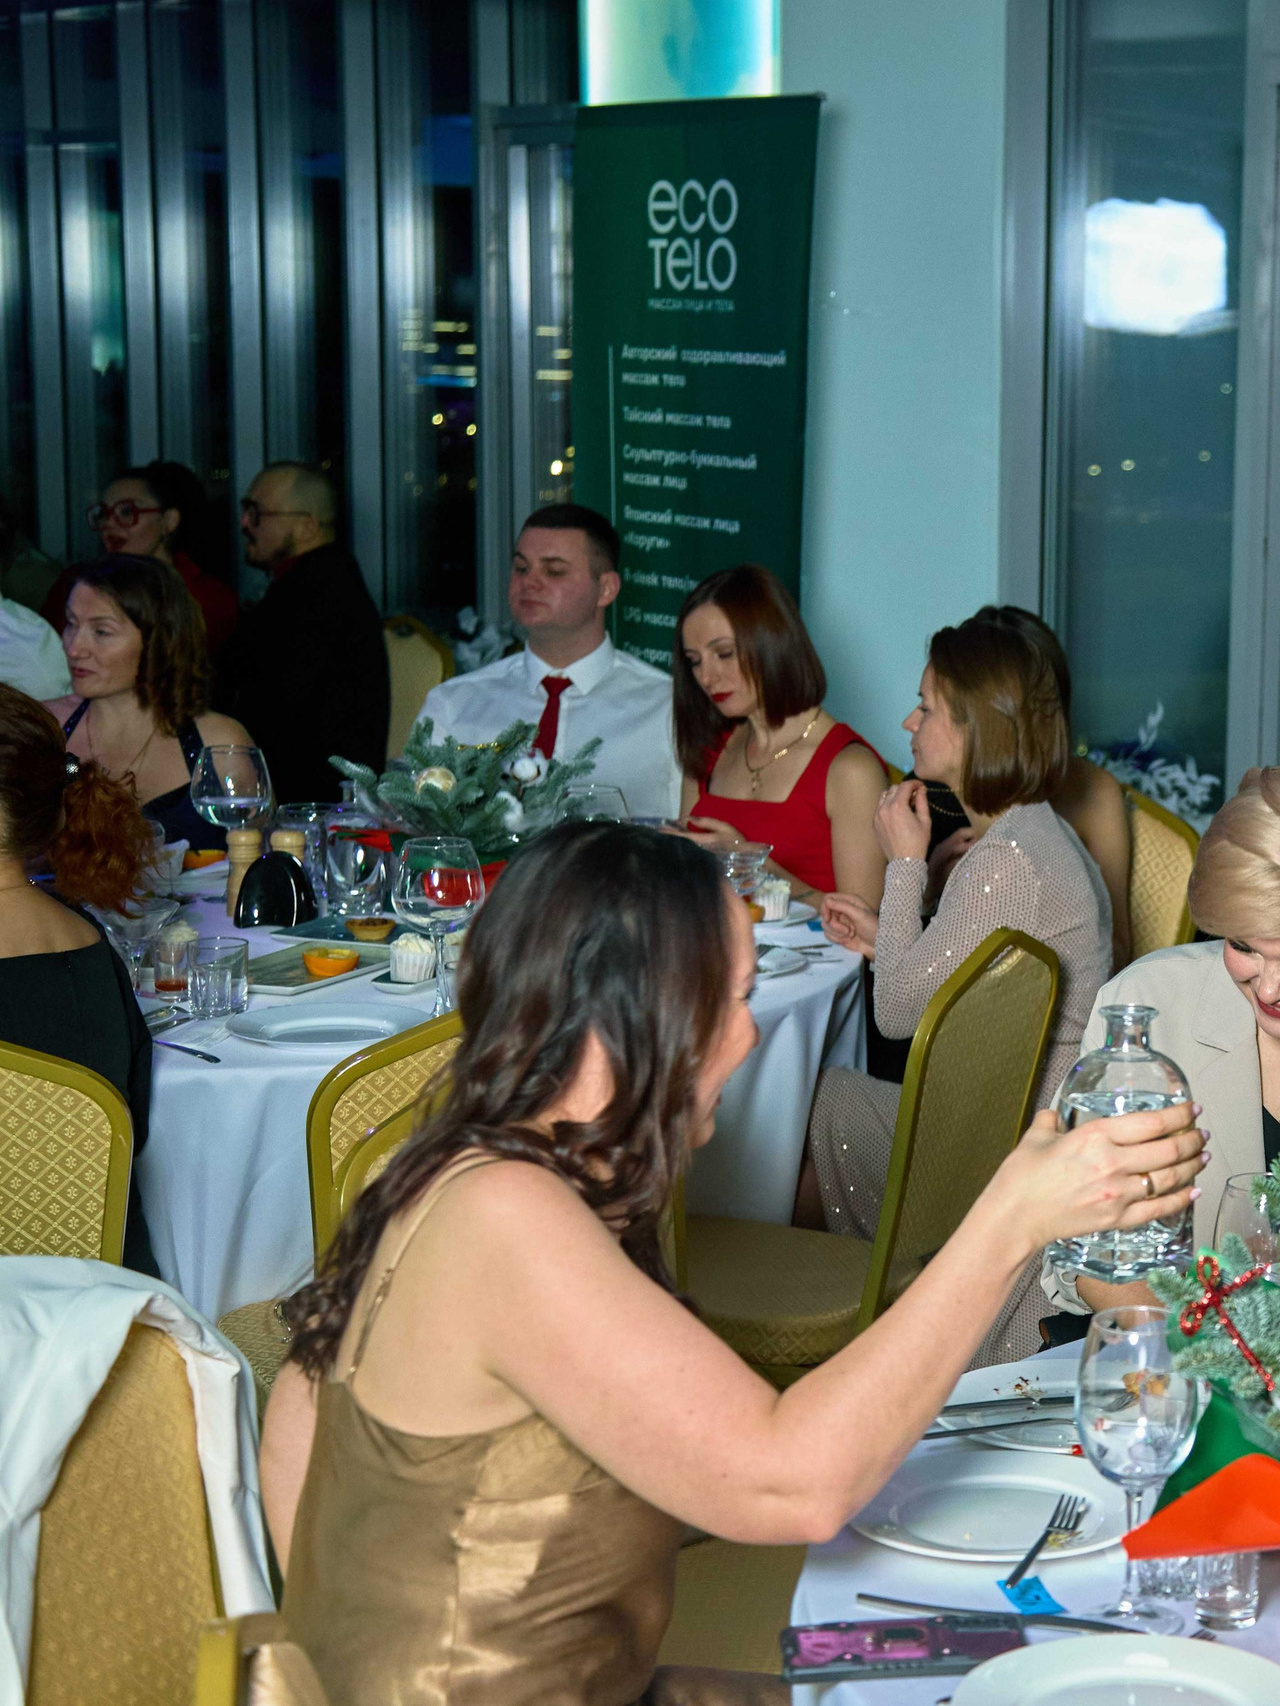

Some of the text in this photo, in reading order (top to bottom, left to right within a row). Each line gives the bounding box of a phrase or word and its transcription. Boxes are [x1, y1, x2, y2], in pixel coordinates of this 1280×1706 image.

[622, 344, 677, 361] Авторский
[622, 372, 686, 387] массаж тела
[623, 405, 731, 429] Тайский массаж тела
[623, 472, 687, 490] массаж лица
[624, 505, 740, 534] Японский массаж лица
[643, 612, 678, 628] масса
